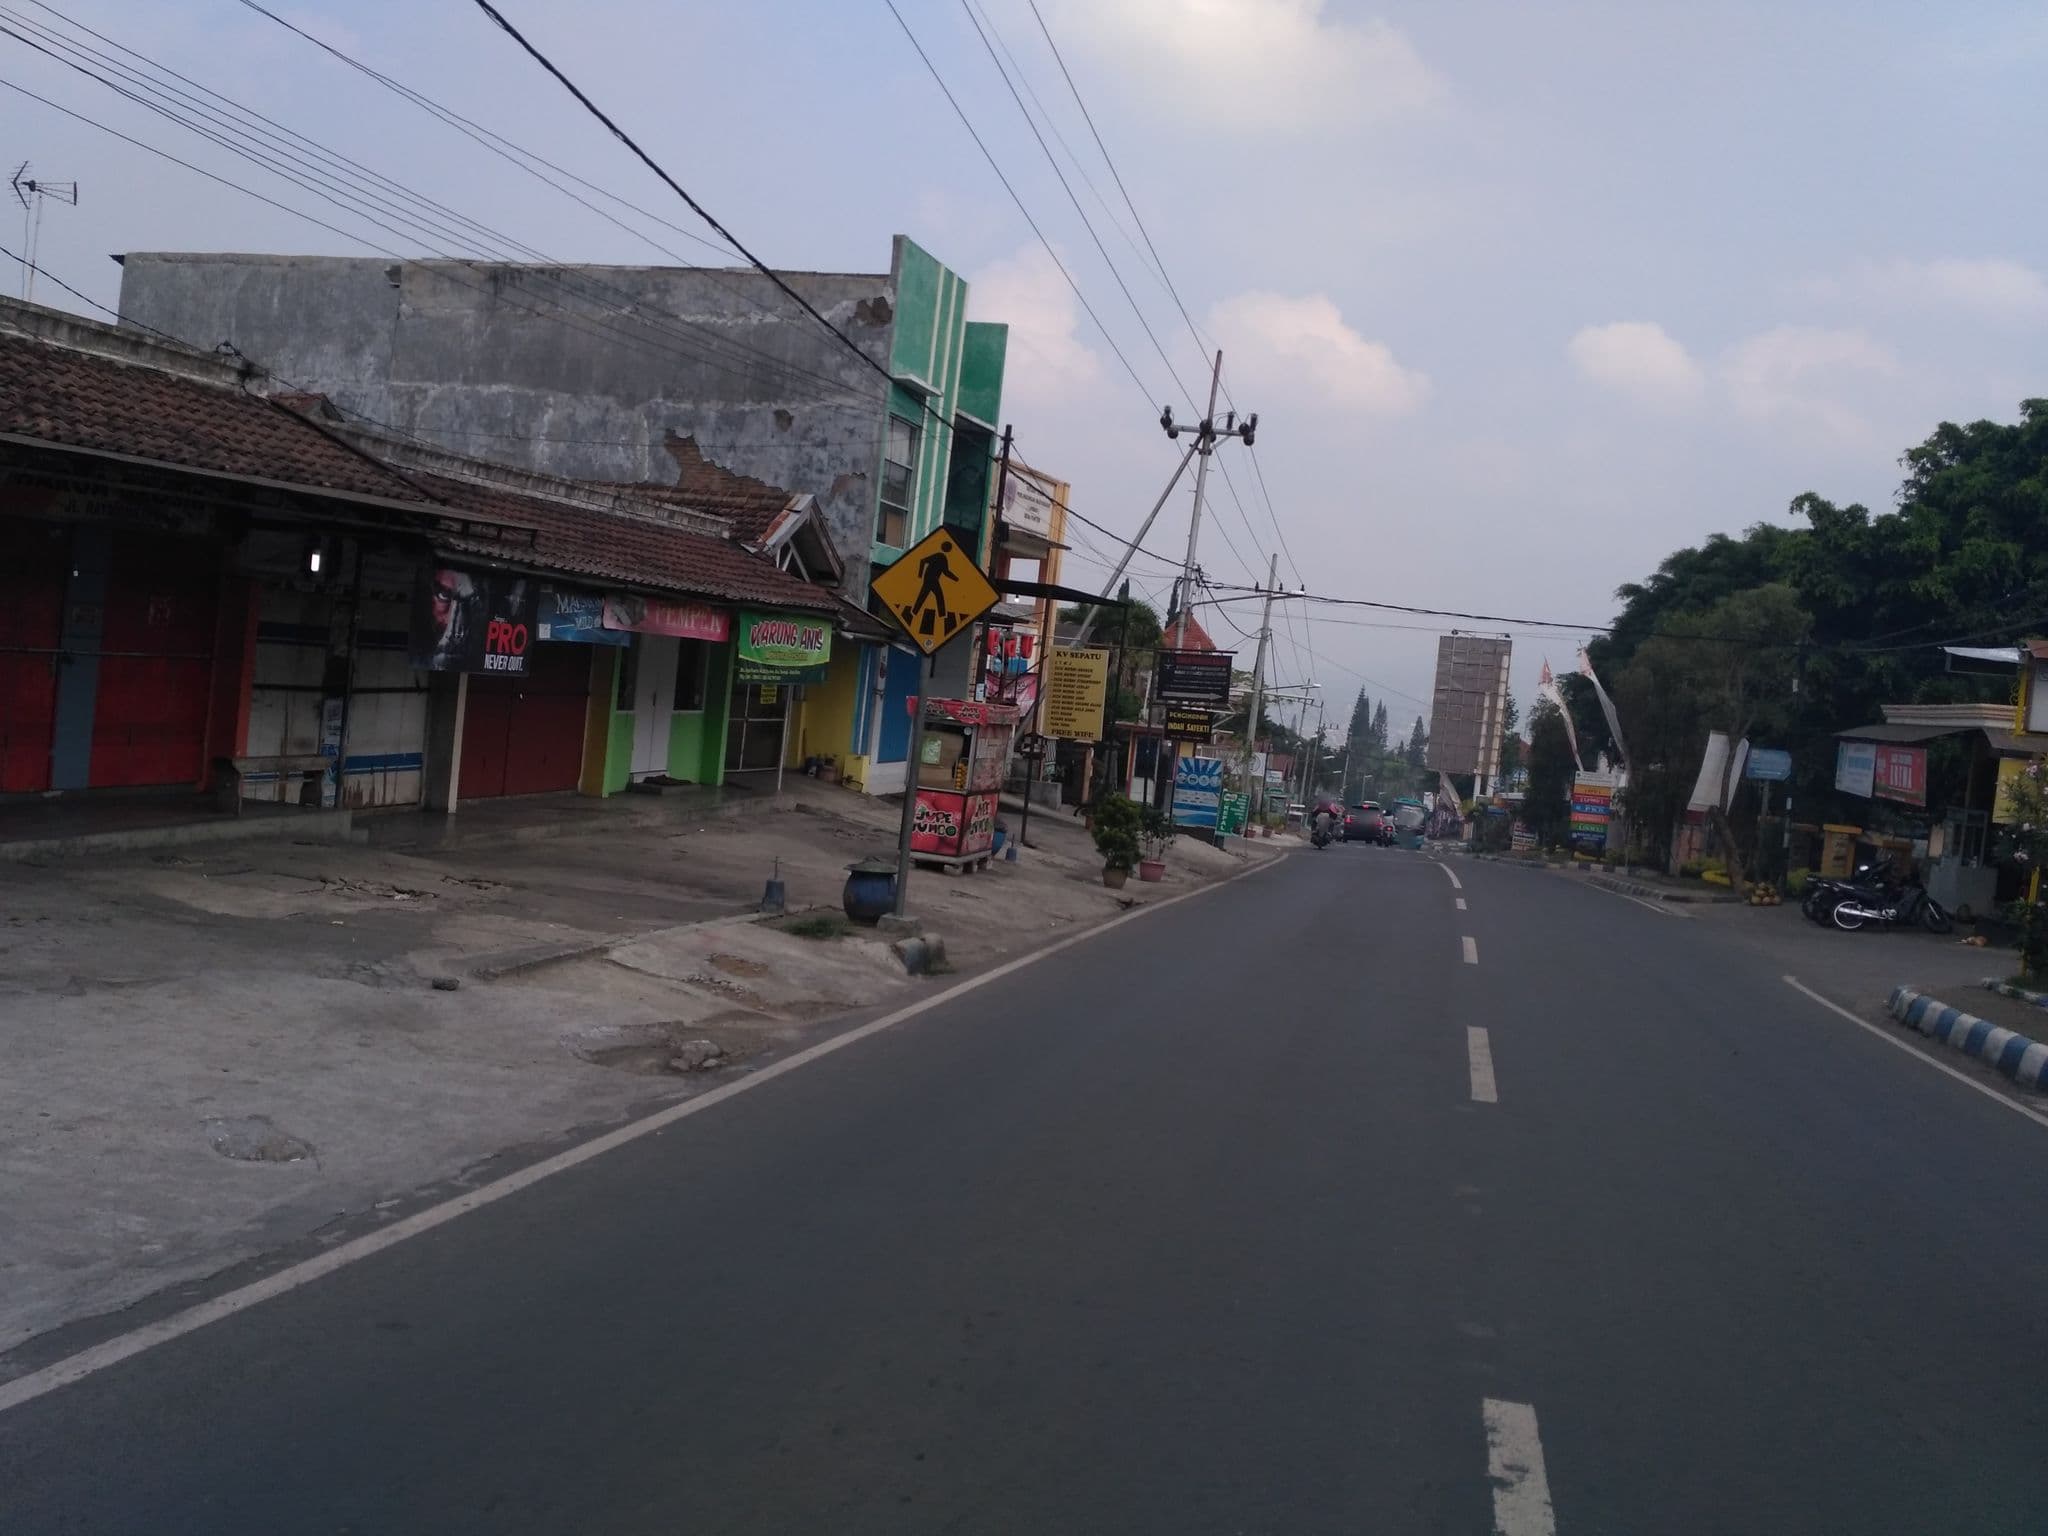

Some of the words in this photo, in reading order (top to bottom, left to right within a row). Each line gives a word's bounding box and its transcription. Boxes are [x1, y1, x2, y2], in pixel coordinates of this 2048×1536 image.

[485, 620, 528, 656] PRO
[751, 620, 798, 649] WARUNG
[800, 626, 825, 652] ANIS
[483, 653, 508, 671] NEVER
[1056, 650, 1068, 658] KV
[1069, 652, 1102, 661] SEPATU
[1167, 721, 1185, 730] INDAH
